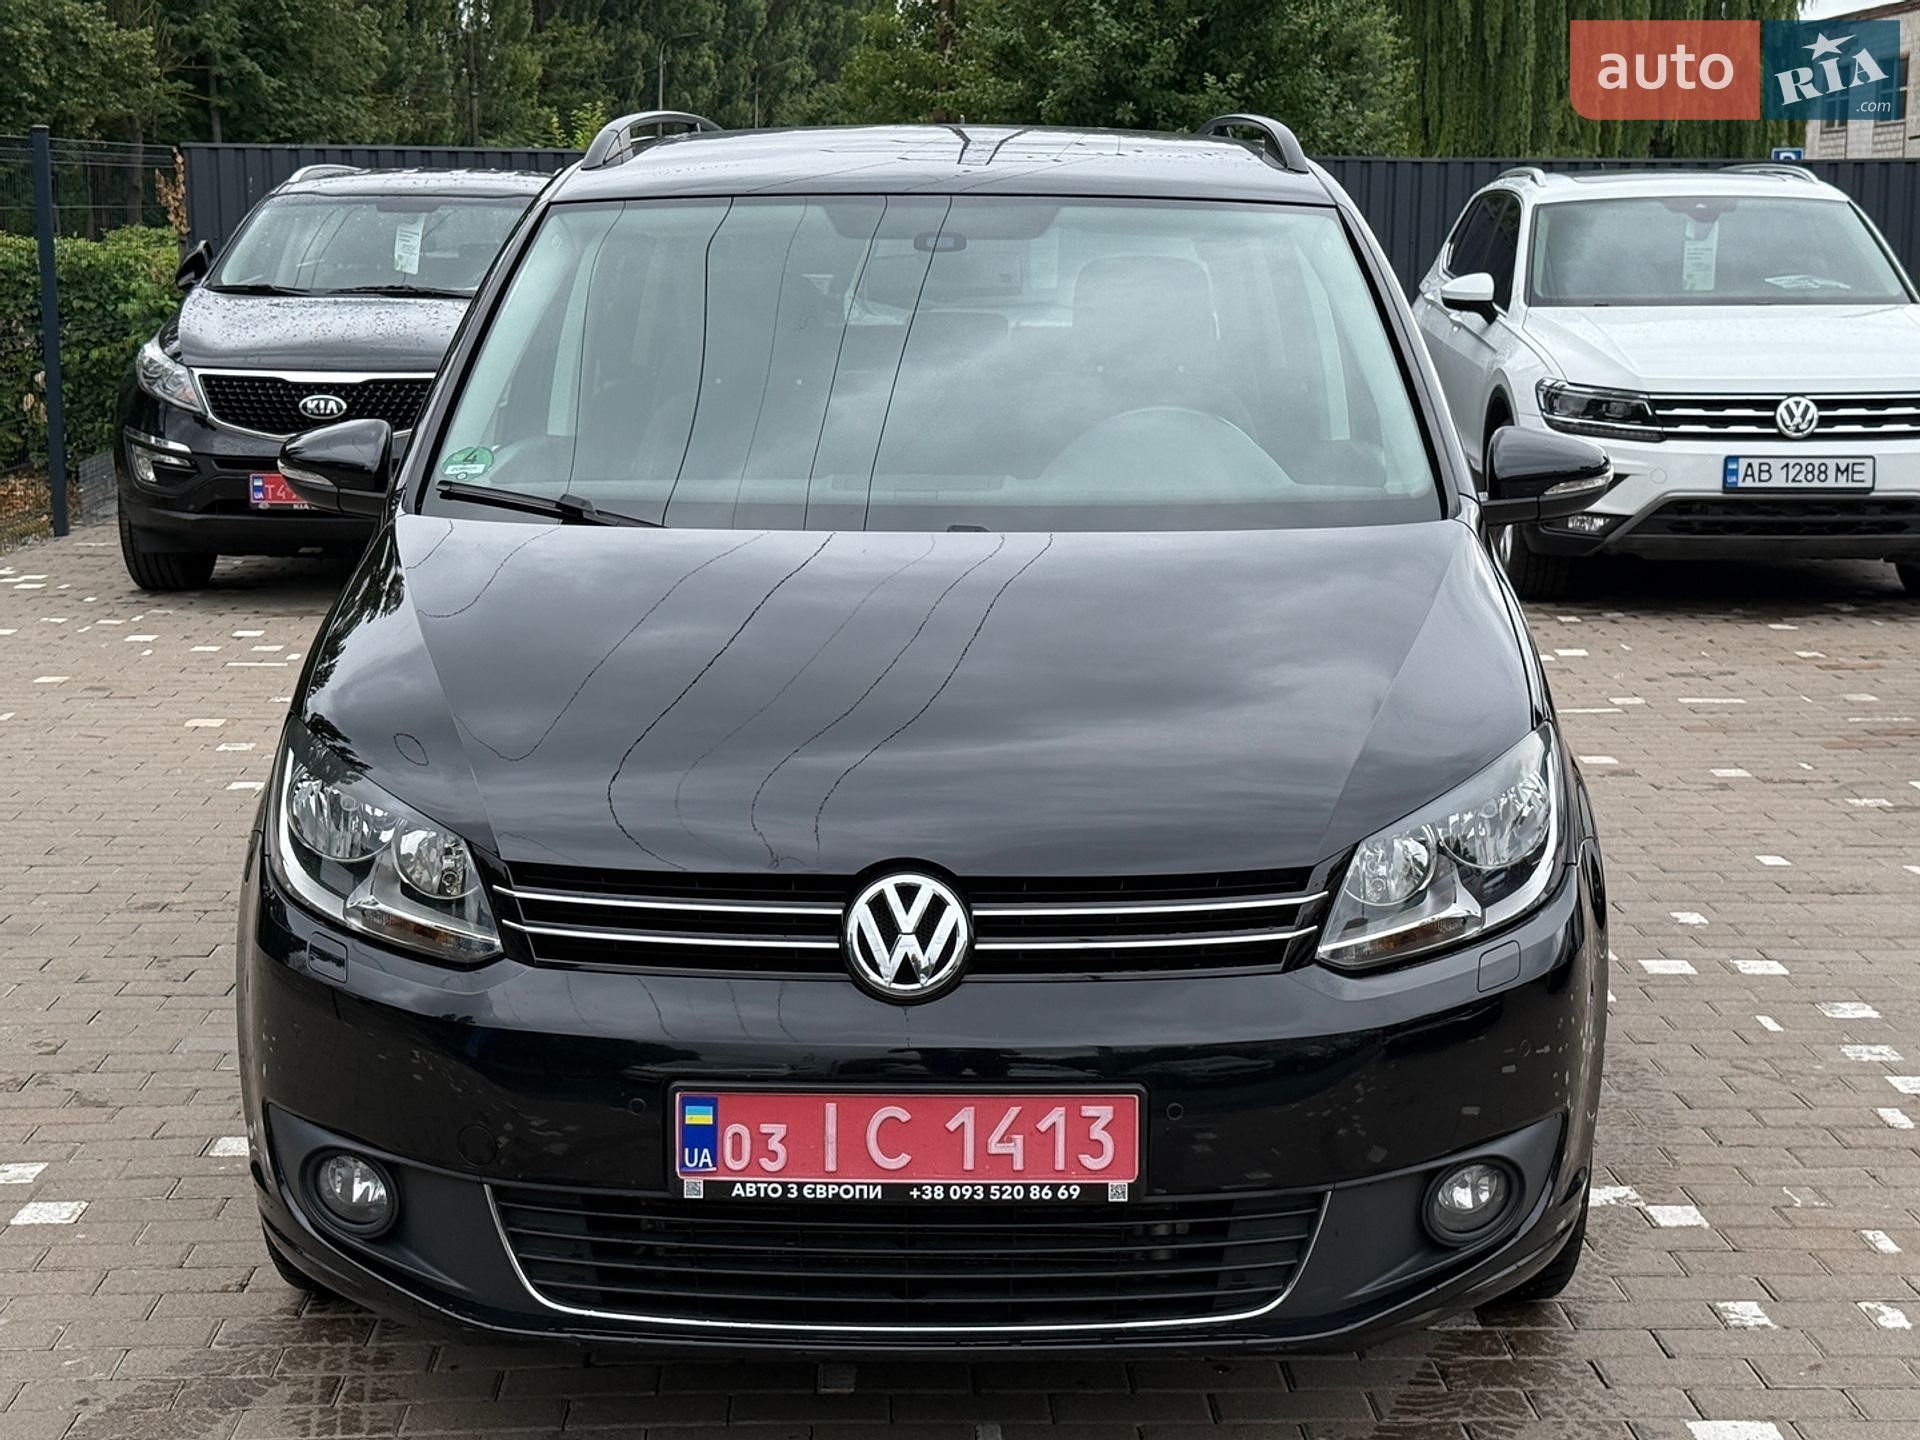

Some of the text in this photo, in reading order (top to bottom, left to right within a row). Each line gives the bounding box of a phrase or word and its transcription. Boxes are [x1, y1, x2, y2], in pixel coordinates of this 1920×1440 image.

[306, 400, 339, 414] KIA
[1742, 462, 1866, 483] AB 1288 ME
[723, 1124, 788, 1172] 03
[945, 1106, 1115, 1171] 1413
[684, 1147, 713, 1168] UA
[731, 1183, 782, 1197] АВТО
[803, 1184, 882, 1199] ЄВРОПИ
[909, 1185, 1081, 1200] +38 093 520 86 69
